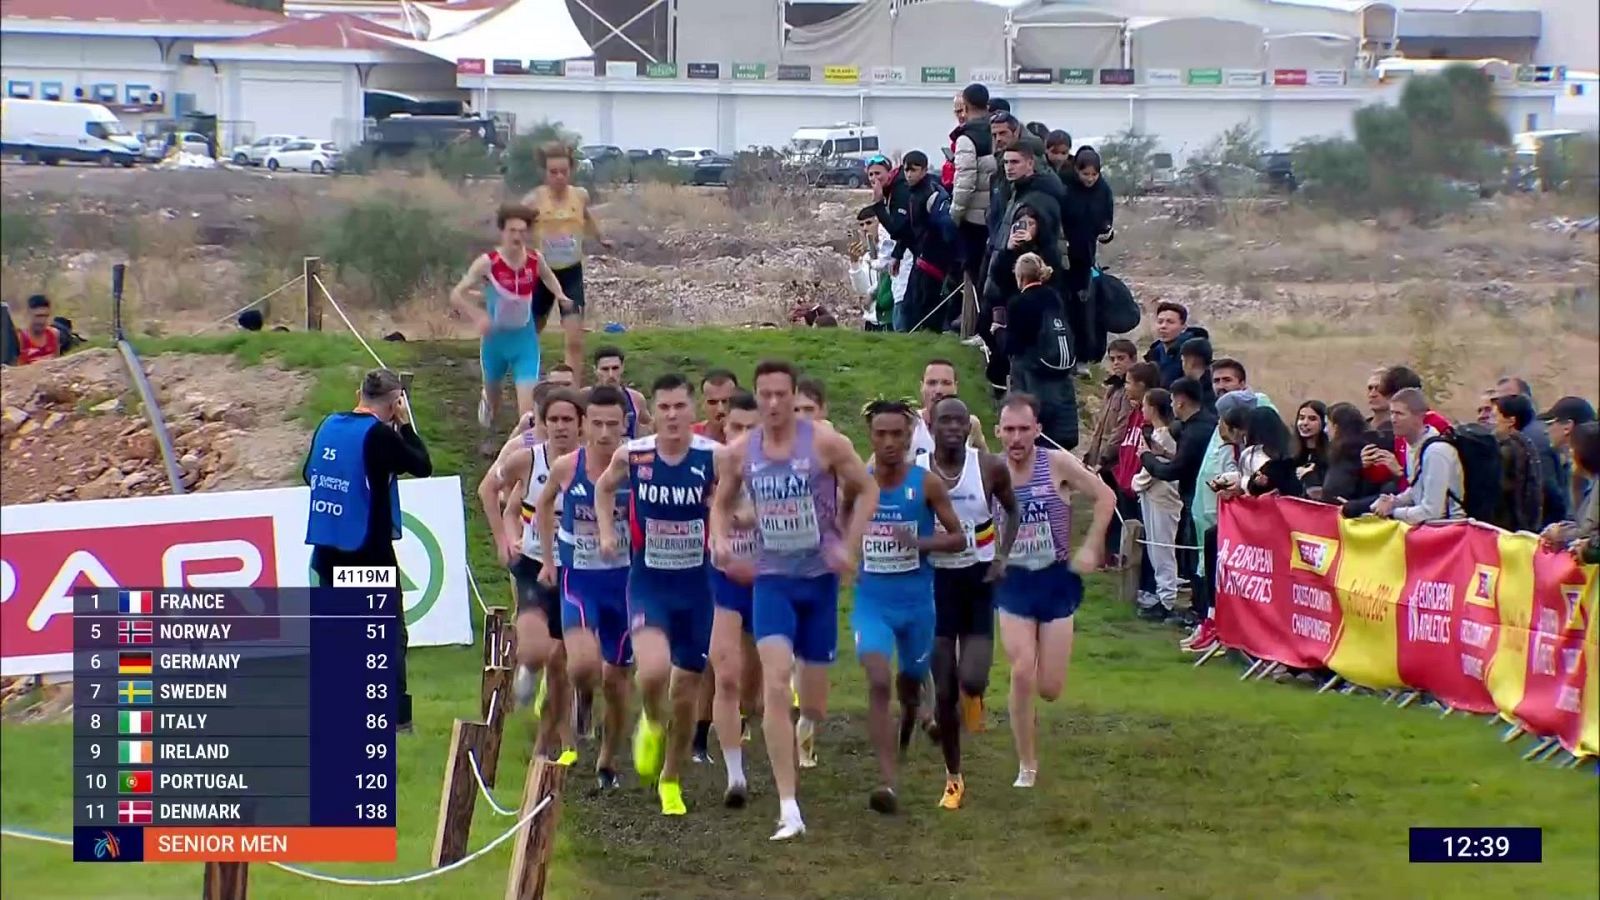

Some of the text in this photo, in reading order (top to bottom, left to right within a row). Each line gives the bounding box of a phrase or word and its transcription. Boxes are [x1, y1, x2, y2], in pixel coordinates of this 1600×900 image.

[322, 447, 337, 461] 25
[317, 481, 349, 494] ATHLETICS
[319, 474, 350, 488] EUROPEAN
[638, 483, 703, 505] NORWAY
[872, 510, 903, 521] ITALIA
[1227, 544, 1274, 574] EUROPEAN
[1224, 570, 1273, 604] ATHLETICS
[1418, 580, 1455, 611] EUROPEAN
[1416, 613, 1452, 644] ATHLETICS
